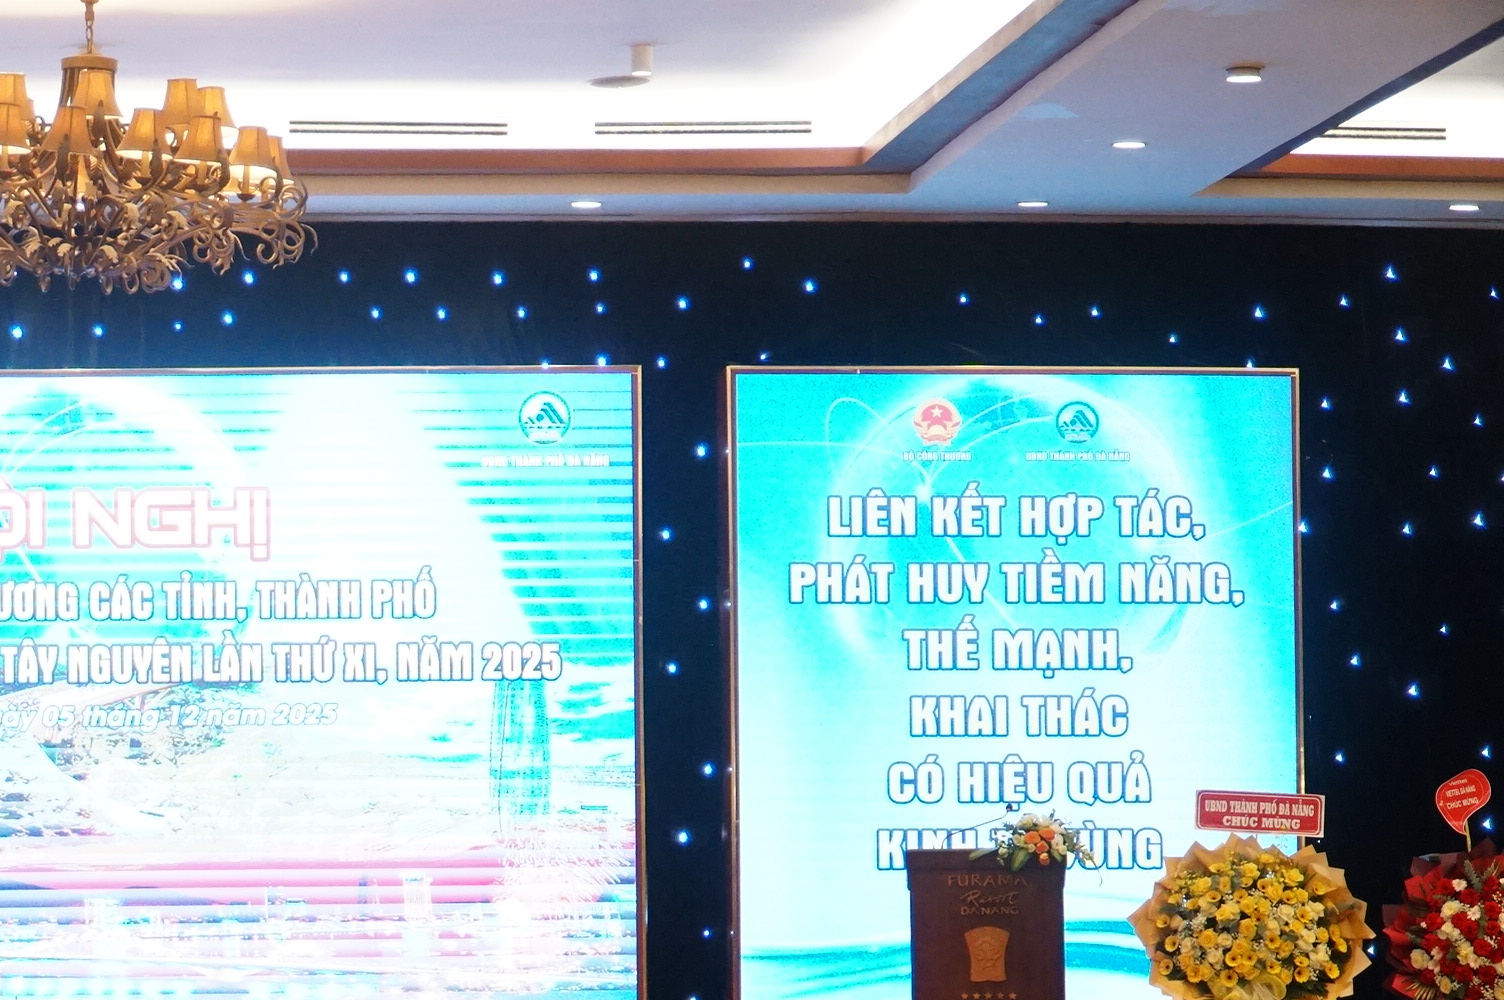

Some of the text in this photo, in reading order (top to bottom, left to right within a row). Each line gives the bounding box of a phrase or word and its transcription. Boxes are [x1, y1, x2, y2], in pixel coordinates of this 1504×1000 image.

[72, 485, 271, 562] NGHỊ
[827, 480, 1205, 546] LIÊN KẾT HỢP TÁC,
[89, 573, 154, 622] CÁC
[163, 569, 248, 623] TỈNH,
[256, 572, 361, 620] THÀNH
[371, 565, 437, 620] PHỐ
[788, 547, 1245, 608] PHÁT HUY TIỀM NĂNG,
[0, 638, 59, 685] TÂY
[67, 636, 193, 685] NGUYÊN
[203, 628, 263, 684] LẦN
[271, 634, 338, 683] THỨ
[343, 641, 388, 685] XI,
[396, 635, 474, 683] NĂM
[480, 640, 563, 682] 2025
[903, 614, 1133, 679] THẾ MẠNH,
[42, 705, 76, 728] 05
[81, 702, 162, 733] tháng
[169, 704, 199, 727] 12
[205, 702, 267, 727] năm
[272, 702, 338, 726] 2025
[909, 687, 1128, 737] KHAI THÁC
[887, 749, 1152, 812] CÓ HIỆU QUẢ
[1204, 799, 1227, 813] UBND
[1229, 798, 1258, 815] THÀNH
[1259, 797, 1277, 815] PHỐ
[1278, 800, 1293, 816] ĐÀ
[1222, 813, 1258, 827] CHÚC
[947, 873, 1028, 887] FURAMA
